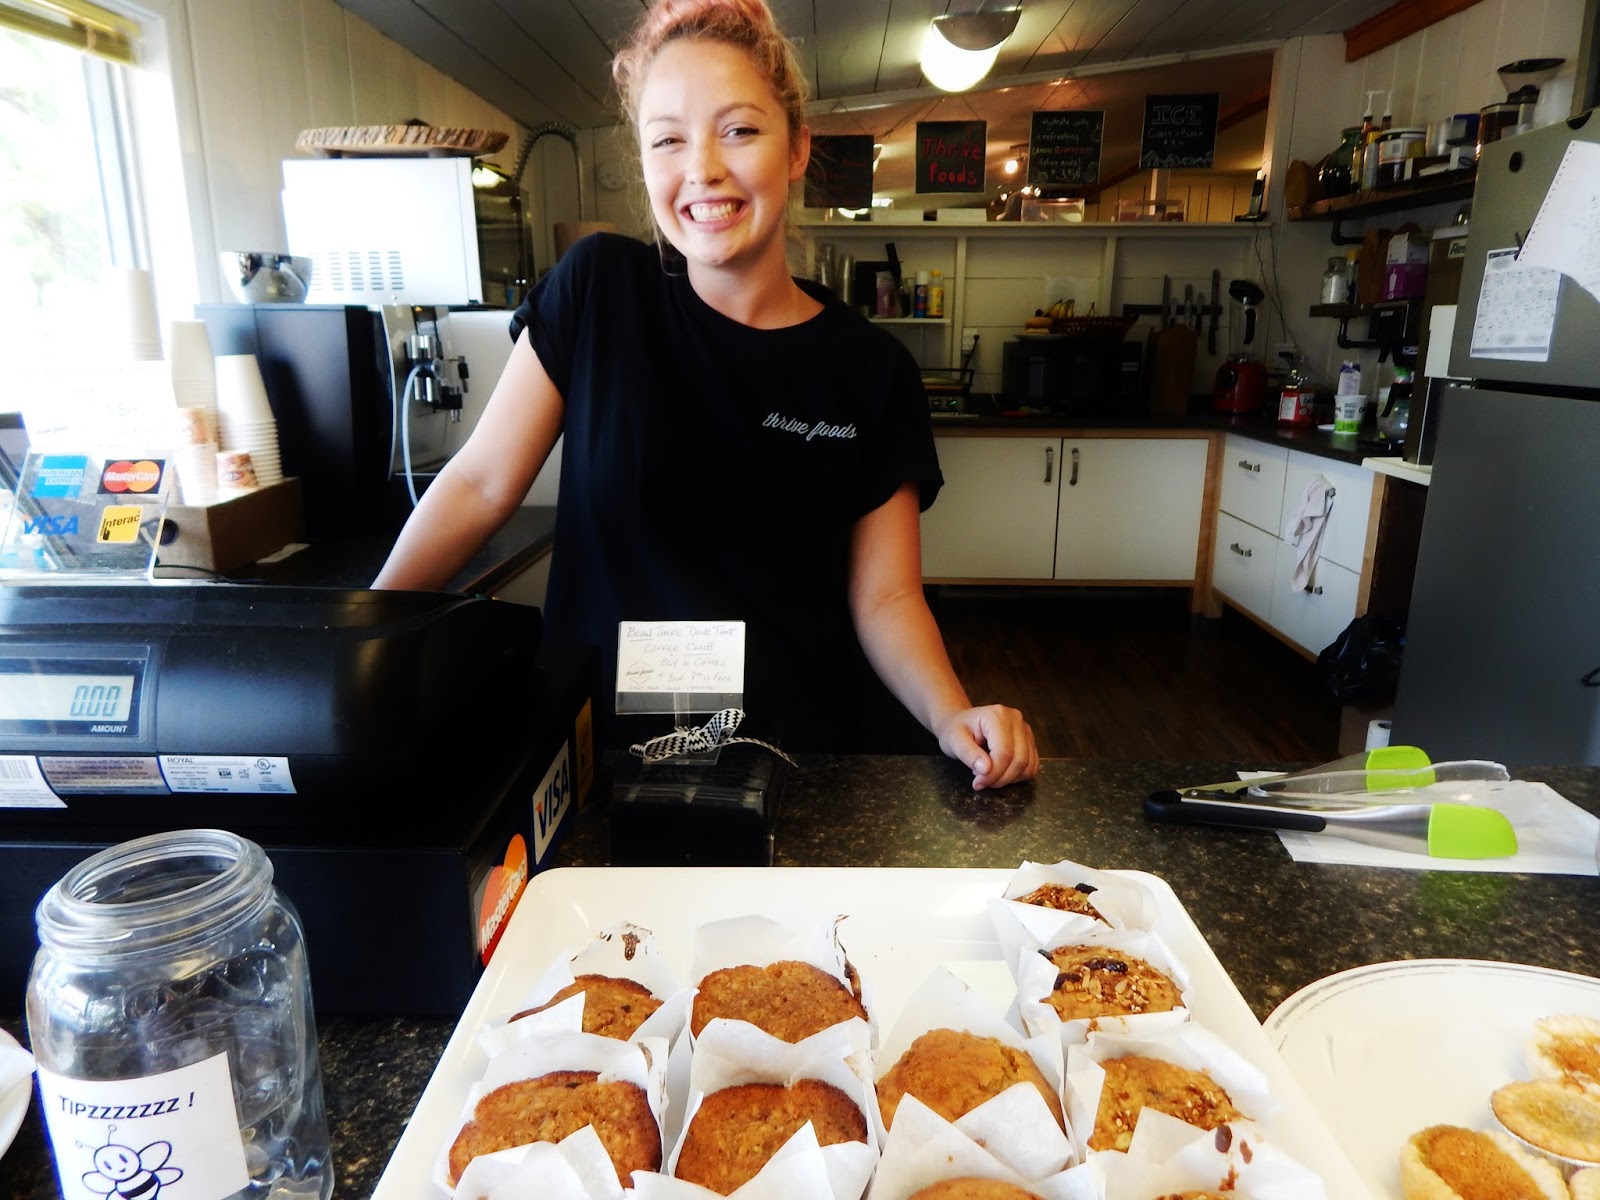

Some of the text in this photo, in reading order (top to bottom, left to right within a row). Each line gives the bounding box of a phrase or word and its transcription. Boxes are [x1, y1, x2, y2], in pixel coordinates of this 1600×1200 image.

[1151, 105, 1202, 125] ICE
[923, 138, 981, 160] Thrive
[762, 412, 857, 441] thrive foods
[104, 471, 159, 481] MasterCard
[24, 515, 79, 535] VISA
[101, 514, 141, 530] Interac
[91, 725, 128, 733] AMOUNT
[535, 759, 570, 840] VISA
[480, 857, 527, 956] MasterCard
[59, 1095, 180, 1120] TIPZZZZZZZ
